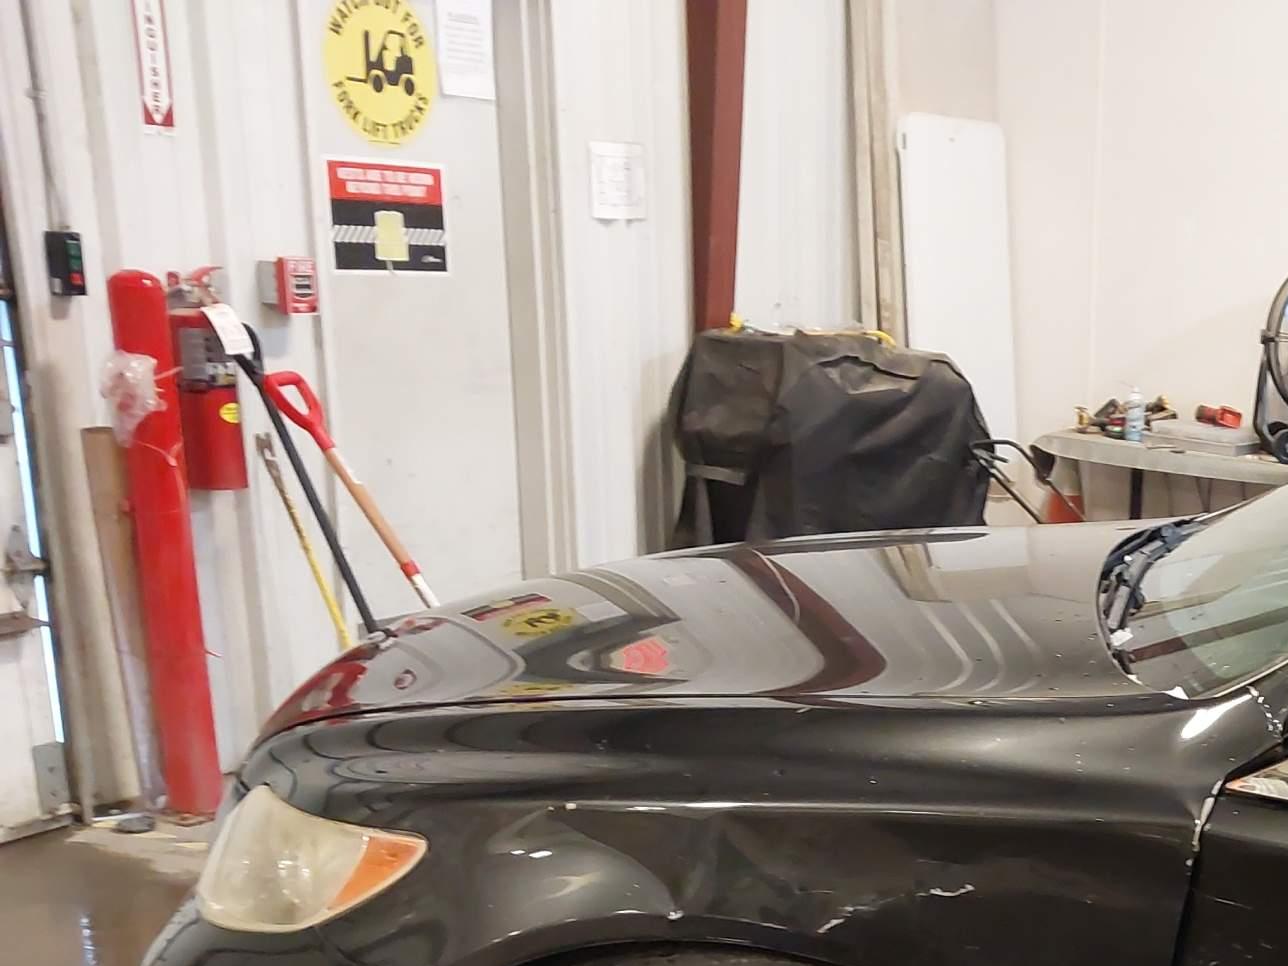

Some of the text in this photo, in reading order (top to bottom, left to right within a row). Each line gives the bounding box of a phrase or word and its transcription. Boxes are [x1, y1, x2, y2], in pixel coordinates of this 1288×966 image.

[401, 11, 424, 48] FOR
[332, 81, 429, 139] FORK LIFT TRUCKS
